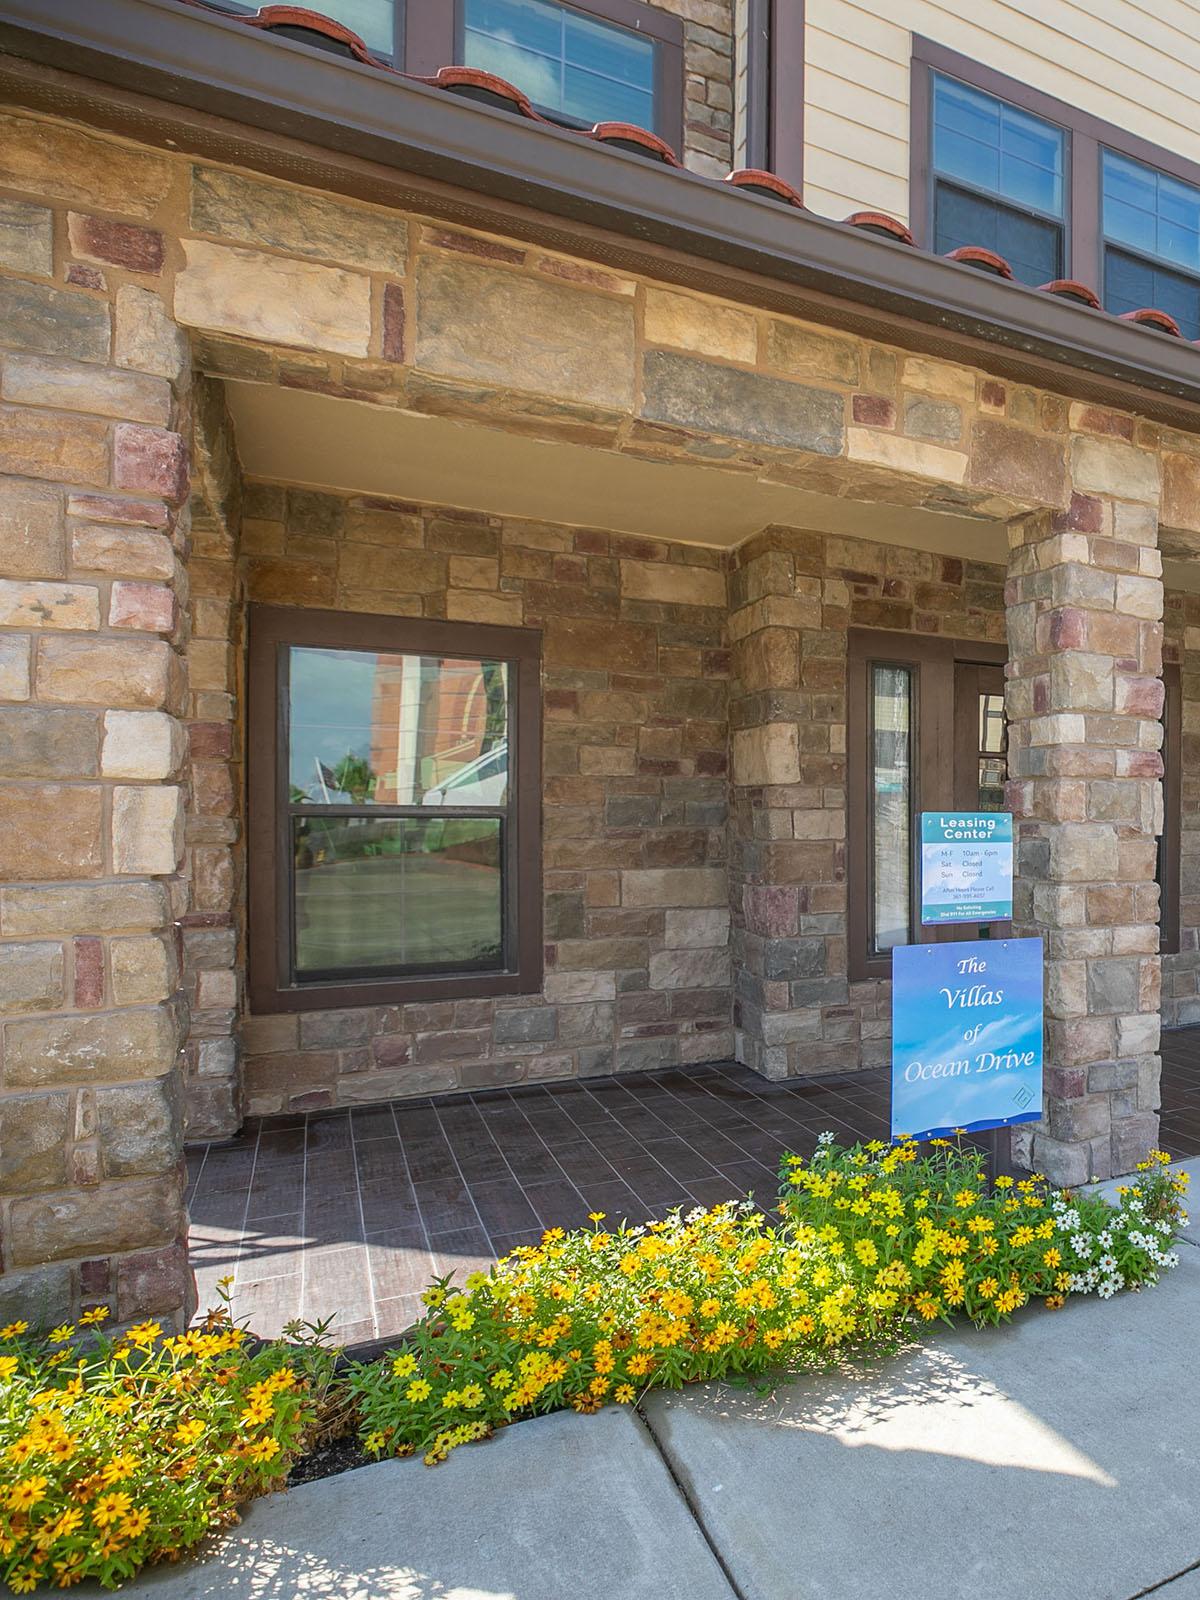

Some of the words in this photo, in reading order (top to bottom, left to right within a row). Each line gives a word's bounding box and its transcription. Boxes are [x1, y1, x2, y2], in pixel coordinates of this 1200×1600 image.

[940, 817, 996, 829] Leasing
[944, 830, 992, 839] Center
[957, 957, 986, 974] The
[940, 984, 1004, 1009] Villas
[964, 1024, 982, 1045] of
[904, 1059, 970, 1083] Ocean
[975, 1049, 1035, 1073] Drive
